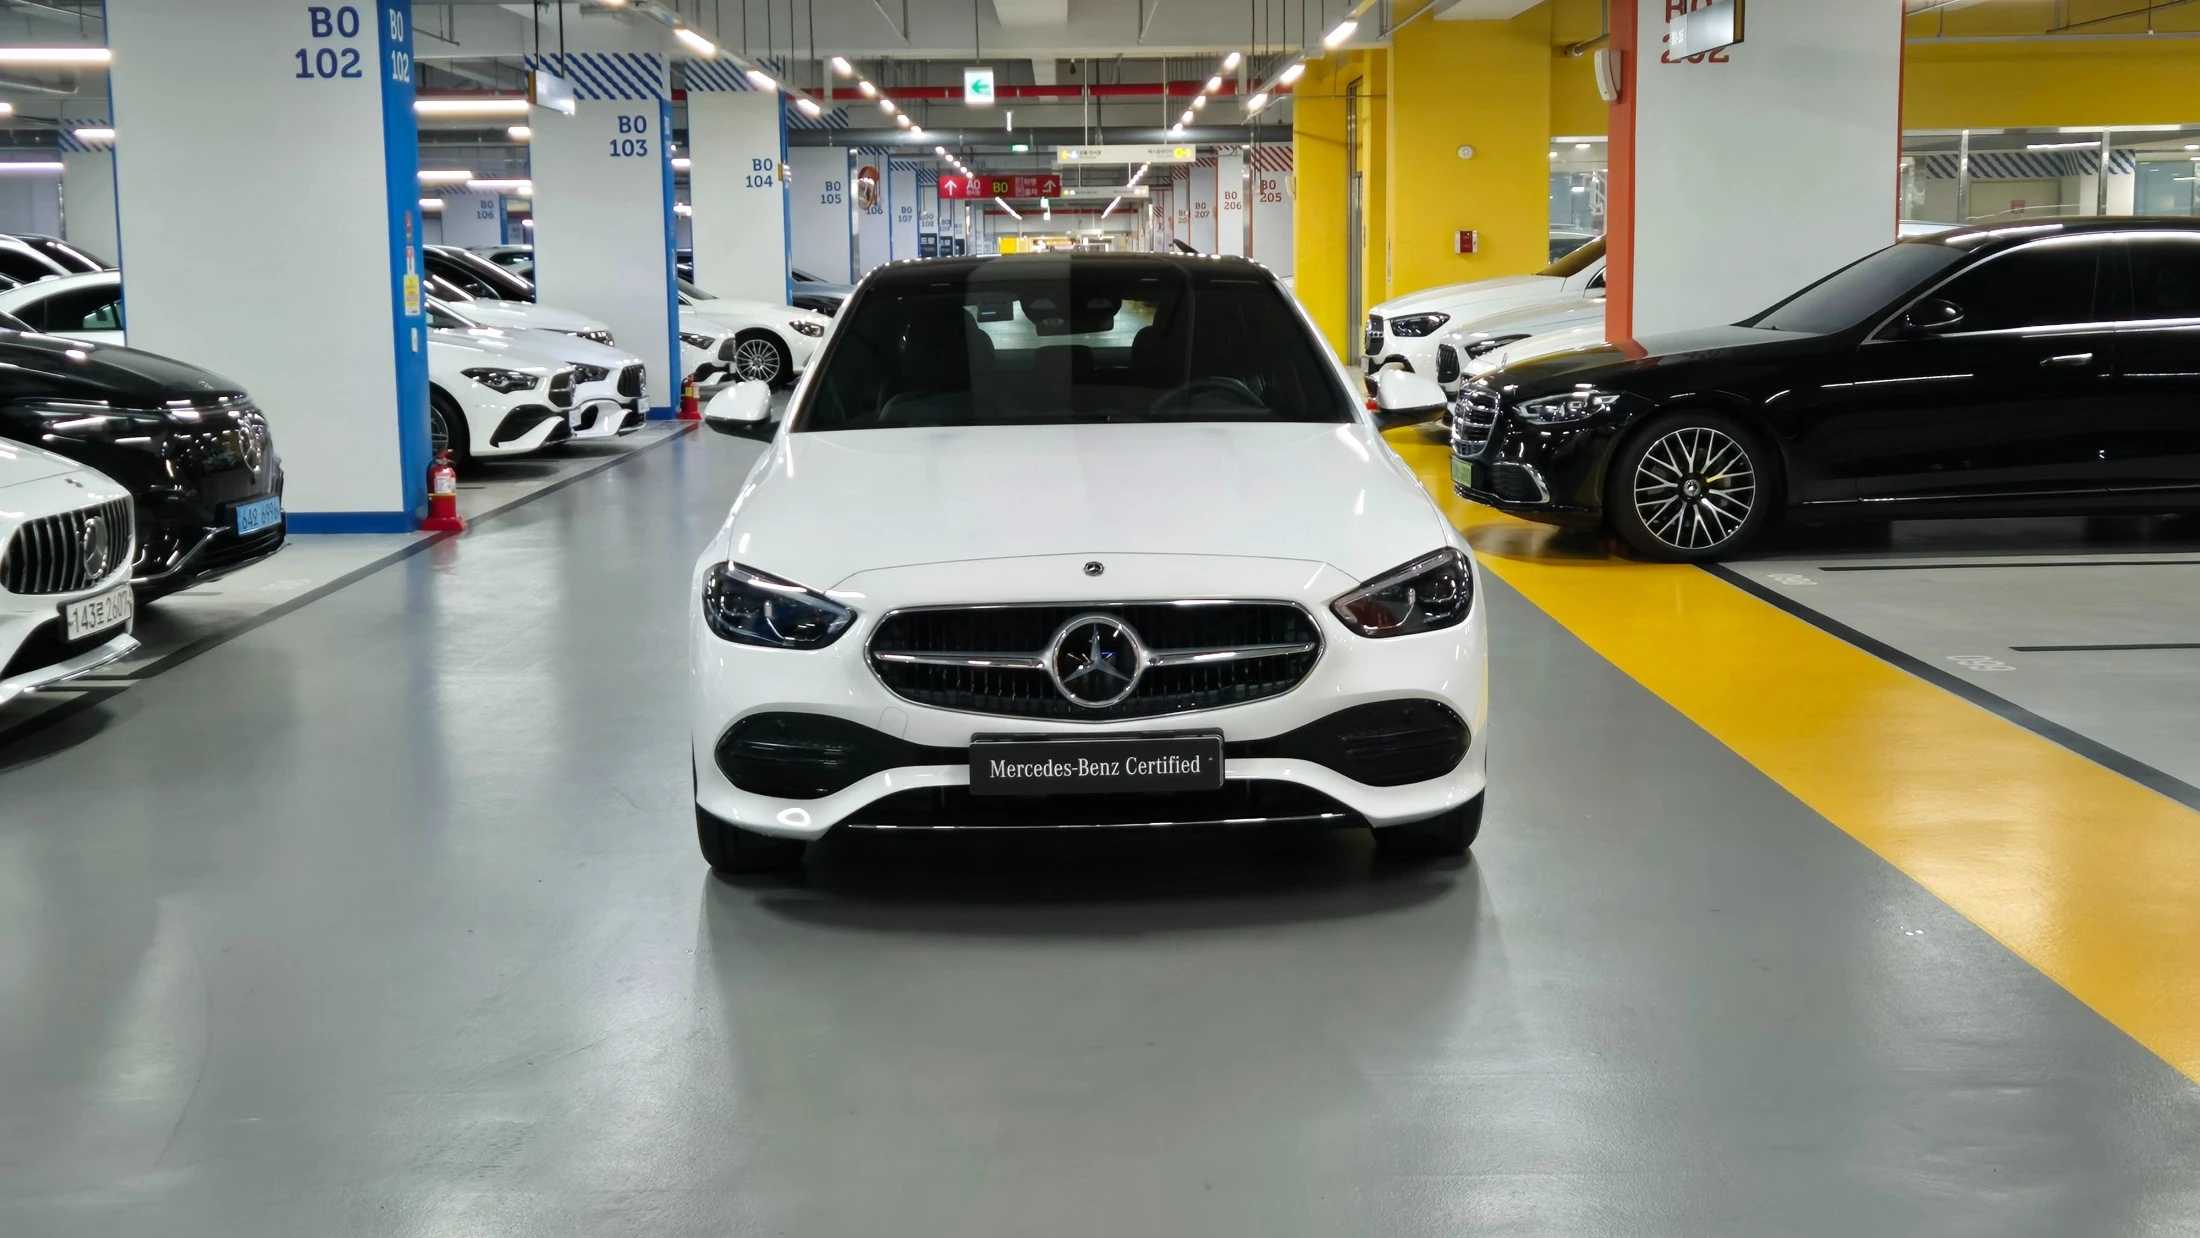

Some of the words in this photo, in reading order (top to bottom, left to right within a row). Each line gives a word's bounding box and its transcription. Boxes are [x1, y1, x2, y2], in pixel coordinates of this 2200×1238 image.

[308, 6, 360, 38] B0
[389, 8, 404, 42] B0
[294, 47, 363, 78] 102
[391, 50, 410, 83] 102
[617, 115, 647, 134] B0
[610, 139, 648, 157] 103
[752, 158, 773, 172] B0
[746, 175, 773, 188] 104
[825, 181, 841, 192] B0
[993, 182, 1008, 193] B0
[821, 194, 842, 204] 105
[1224, 191, 1238, 200] B0
[1260, 192, 1282, 203] 205
[1224, 202, 1242, 210] 206
[476, 211, 495, 220] 106
[898, 215, 913, 223] 107
[1195, 211, 1210, 219] 207
[989, 757, 1120, 778] Mercedes-Benz
[1125, 755, 1201, 776] Certified
